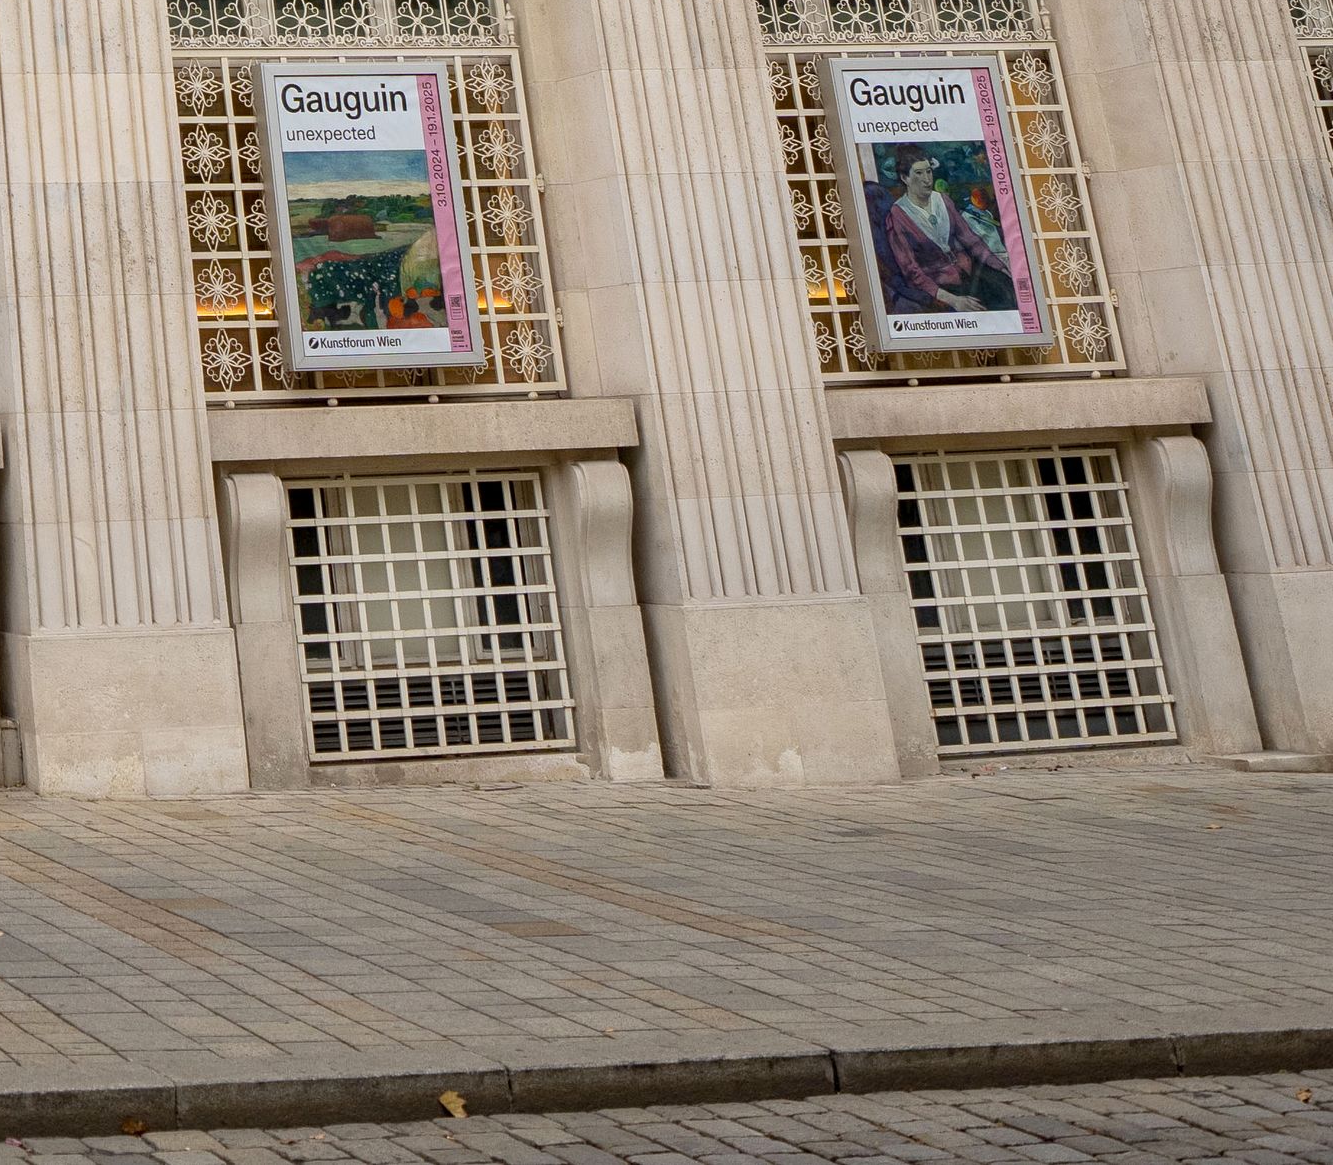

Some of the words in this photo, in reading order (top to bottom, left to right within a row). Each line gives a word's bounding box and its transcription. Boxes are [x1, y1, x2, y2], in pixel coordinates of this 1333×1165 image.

[282, 83, 407, 119] Gauguin
[422, 82, 437, 136] 19.1.2025
[850, 77, 965, 112] Gauguin
[977, 75, 994, 127] 19.1.2025
[287, 126, 375, 144] unexpected
[858, 118, 938, 135] unexpected
[431, 149, 447, 206] 3.10.2024
[990, 140, 1008, 195] 3.10.2024
[320, 337, 375, 348] Kunstforum
[377, 336, 401, 346] Wien
[904, 320, 954, 330] Kunstforum
[955, 319, 978, 328] Wien
